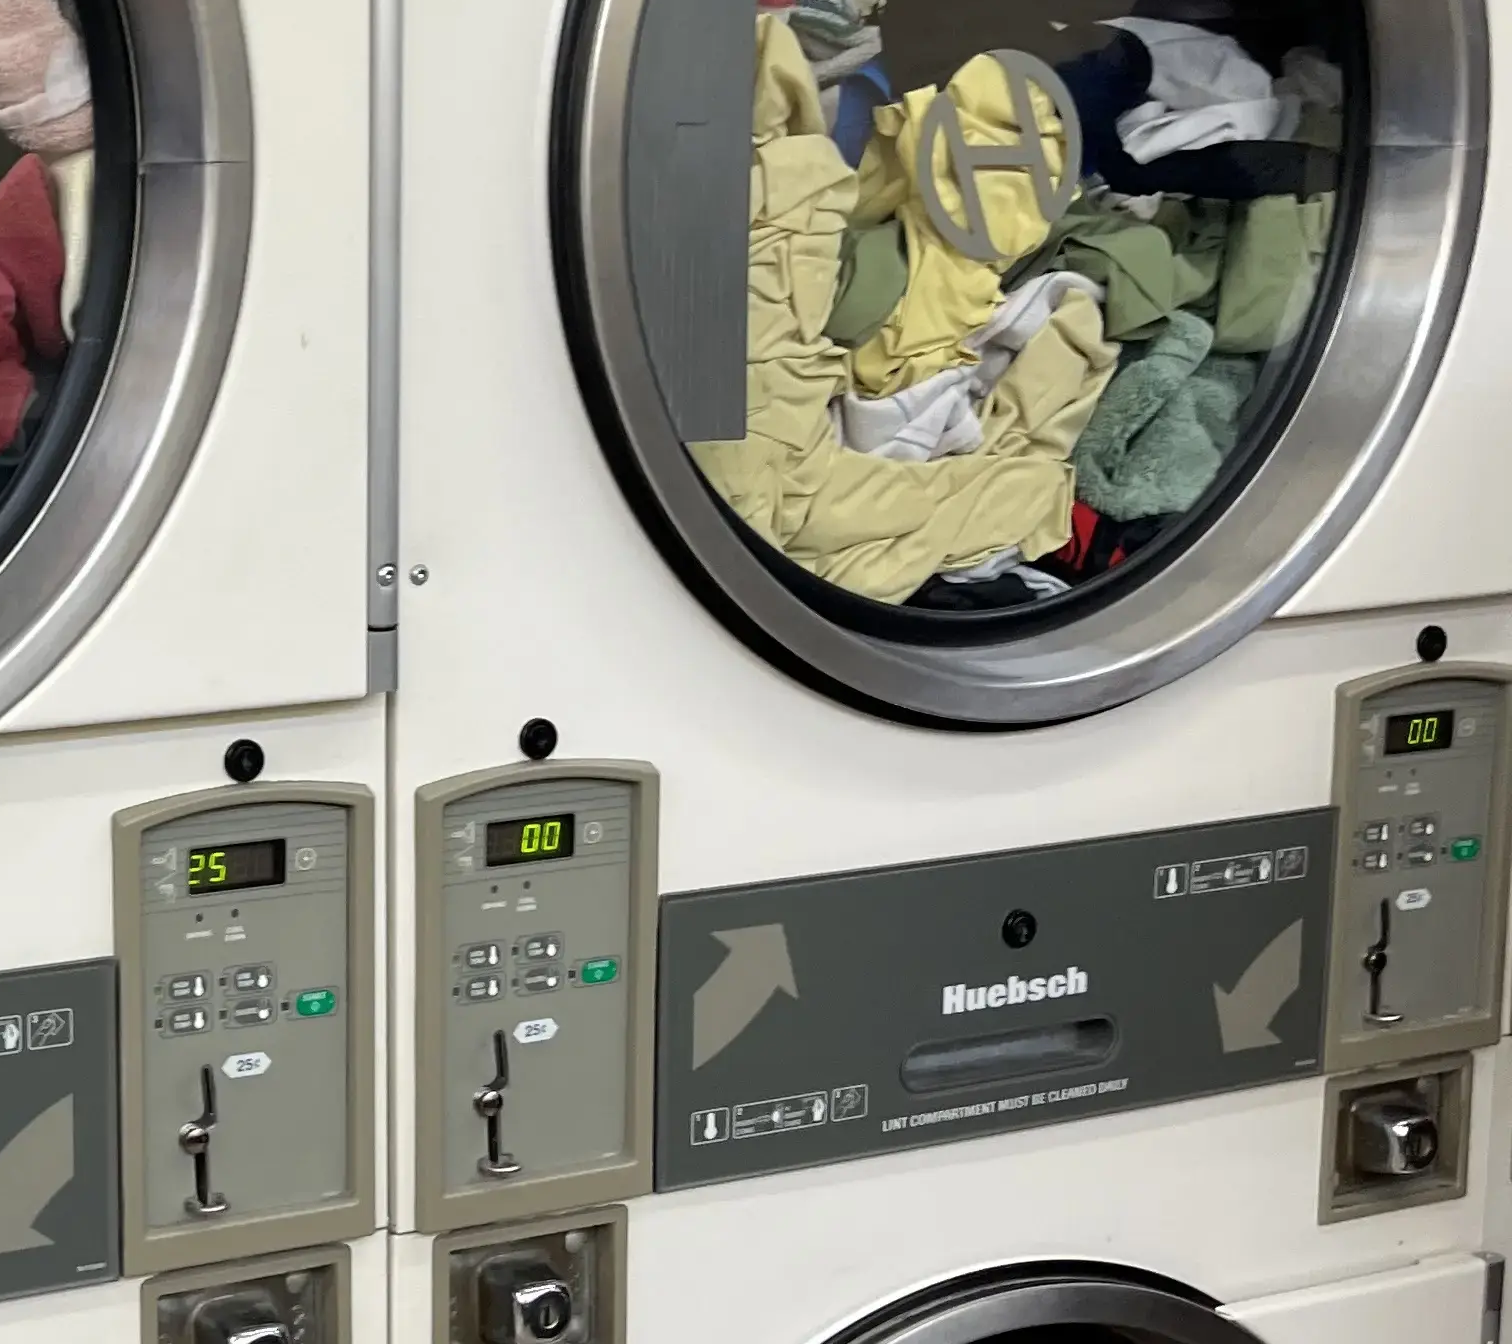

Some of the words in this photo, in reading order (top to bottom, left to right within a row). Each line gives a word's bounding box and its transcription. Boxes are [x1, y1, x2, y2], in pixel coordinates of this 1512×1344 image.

[1408, 717, 1438, 745] 00
[521, 821, 561, 854] 00
[942, 966, 1088, 1015] Huebsch
